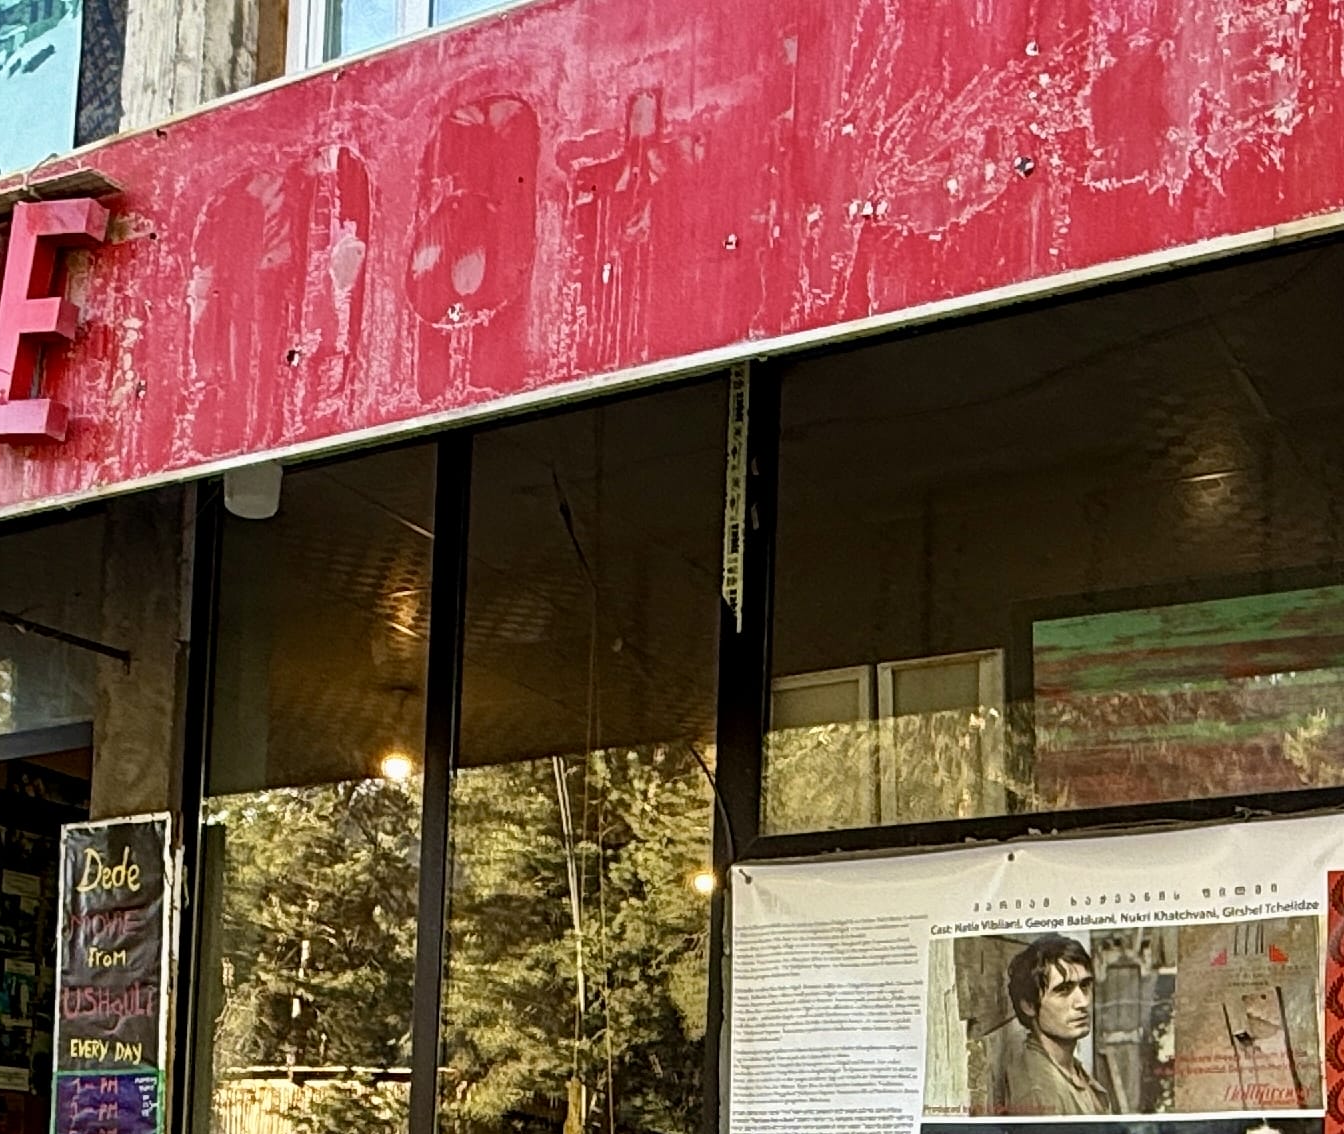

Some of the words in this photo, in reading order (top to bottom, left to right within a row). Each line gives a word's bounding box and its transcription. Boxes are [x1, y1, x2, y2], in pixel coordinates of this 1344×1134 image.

[76, 847, 141, 892] Dede
[1025, 917, 1064, 929] George
[70, 1039, 108, 1062] EVERY
[114, 1042, 143, 1065] DAY
